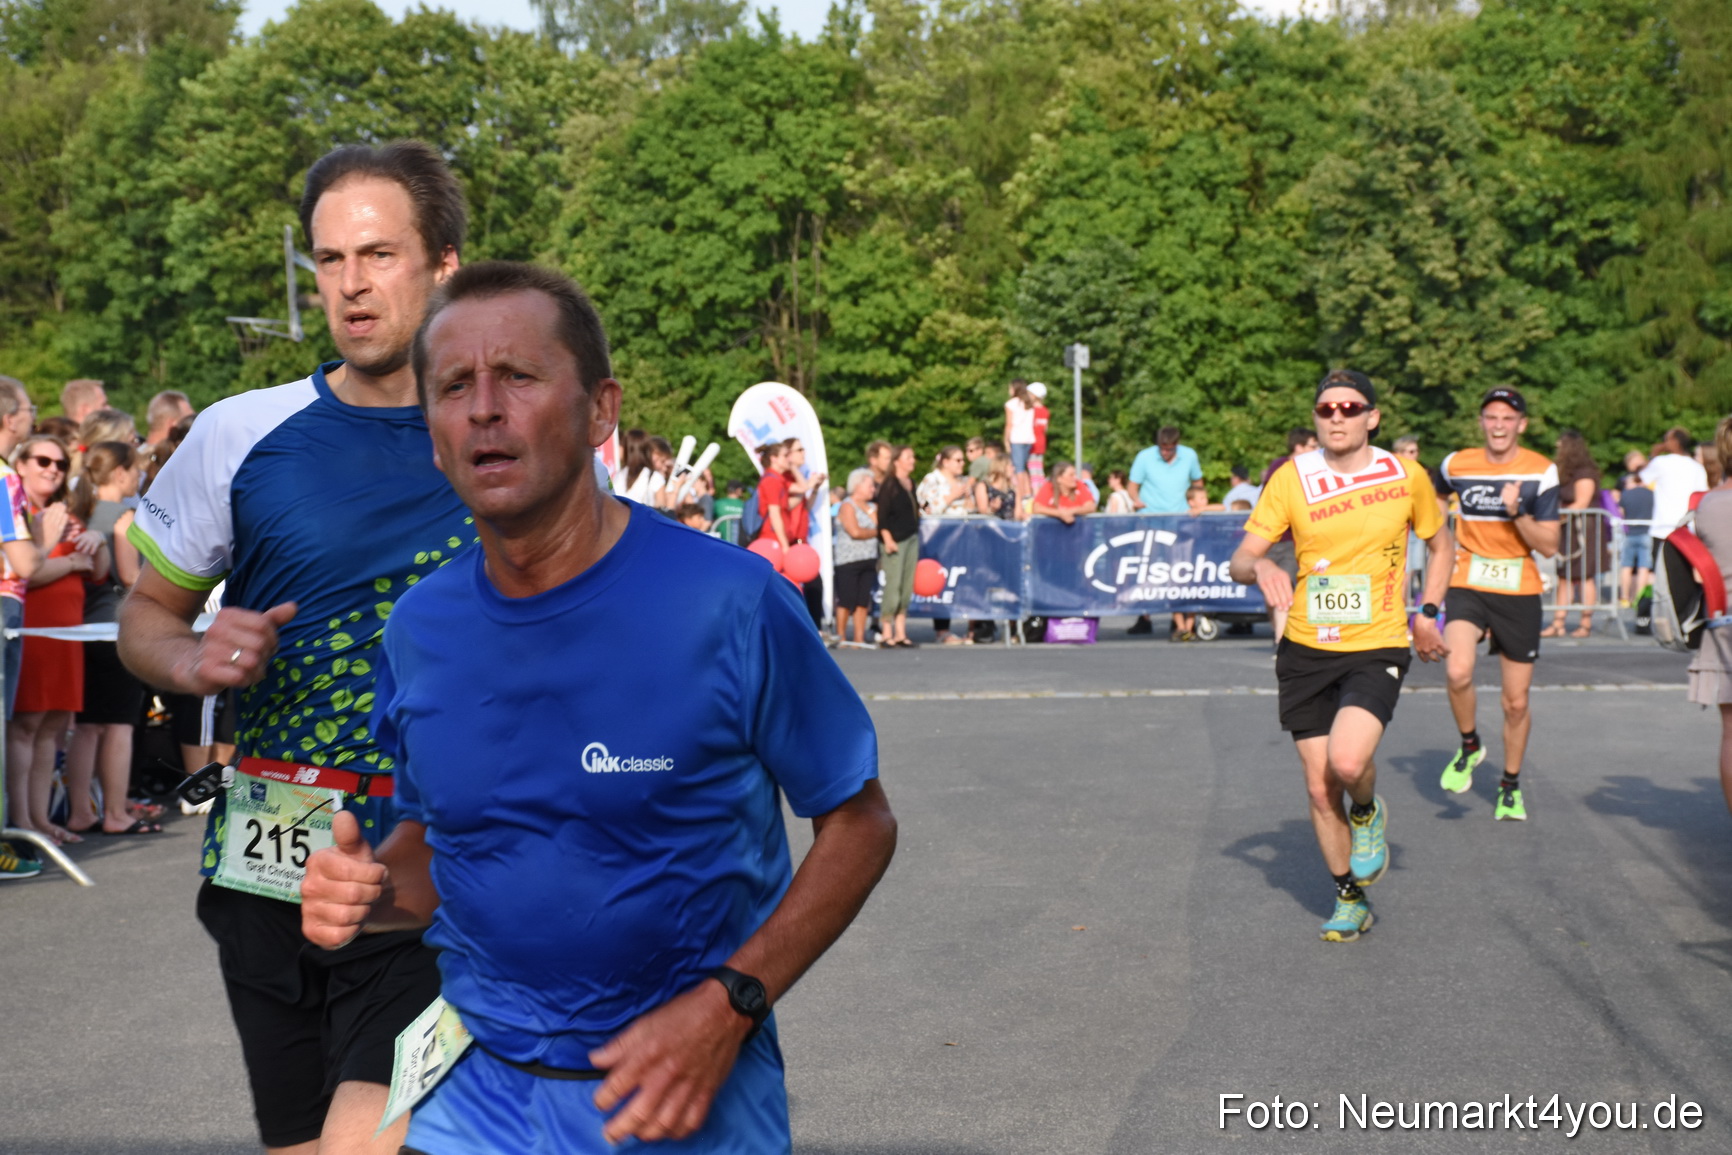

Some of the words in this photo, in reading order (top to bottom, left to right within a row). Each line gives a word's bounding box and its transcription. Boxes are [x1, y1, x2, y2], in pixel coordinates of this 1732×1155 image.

[1309, 499, 1355, 523] MAX
[1360, 485, 1410, 507] BÖGL
[1116, 553, 1232, 585] Fische
[1482, 563, 1508, 579] 751
[1130, 584, 1247, 601] AUTOMOBILE
[1315, 593, 1361, 610] 1603
[621, 755, 674, 772] classic
[244, 818, 311, 869] 215
